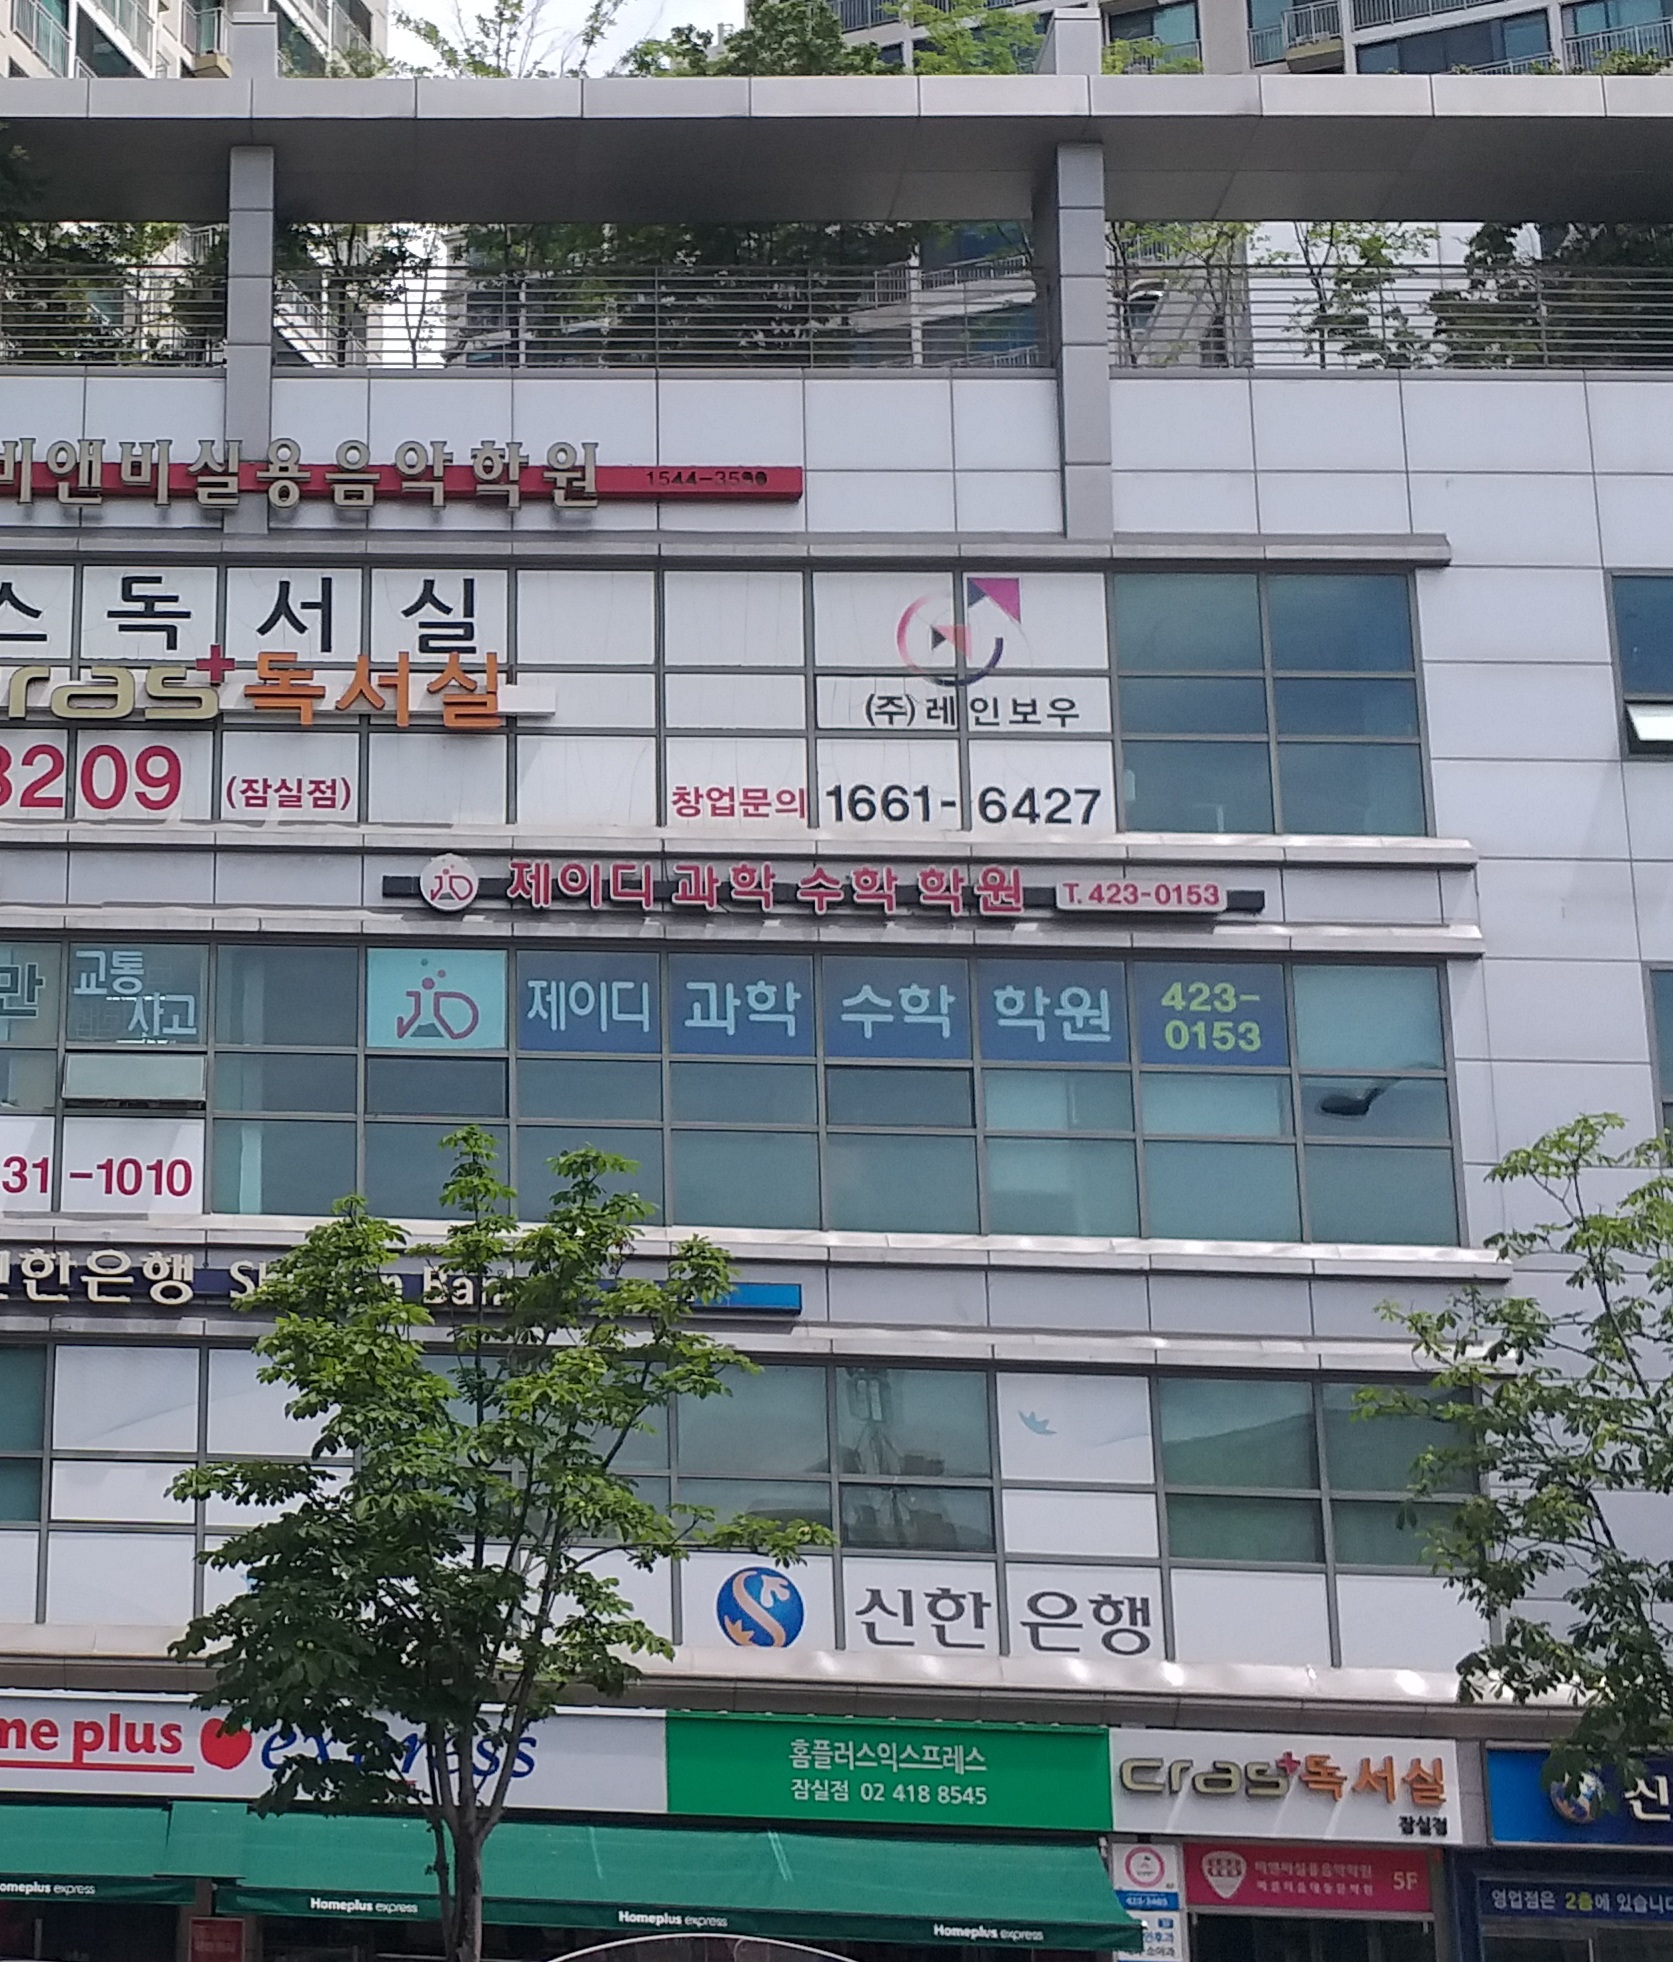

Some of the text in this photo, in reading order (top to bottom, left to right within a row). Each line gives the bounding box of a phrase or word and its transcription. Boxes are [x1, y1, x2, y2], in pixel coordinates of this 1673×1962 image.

[243, 651, 507, 729] 독서실
[0, 744, 352, 811] 209 (잠실점)
[671, 786, 807, 818] 창업문의
[507, 860, 654, 911] 제이디
[673, 862, 777, 911] 과학
[797, 865, 899, 916] 수학
[917, 866, 1023, 916] 학원
[1088, 883, 1222, 907] 423-0153
[73, 950, 145, 996] 교통
[128, 992, 197, 1036] 사고
[527, 980, 650, 1032] 제이디
[684, 980, 801, 1037] 과학
[841, 984, 956, 1039] 수학
[993, 985, 1112, 1042] 학원
[1164, 1020, 1261, 1051] 0153
[72, 1713, 182, 1764] plus
[261, 1731, 538, 1778] exrss
[788, 1739, 987, 1774] 홈플러스익스프레스
[791, 1779, 988, 1805] 잠실점 02 418 8545
[1300, 1754, 1448, 1806] 독서실
[310, 1898, 418, 1914] Homeplus express
[618, 1910, 728, 1927] Homeplus express
[933, 1924, 998, 1940] Homeplus
